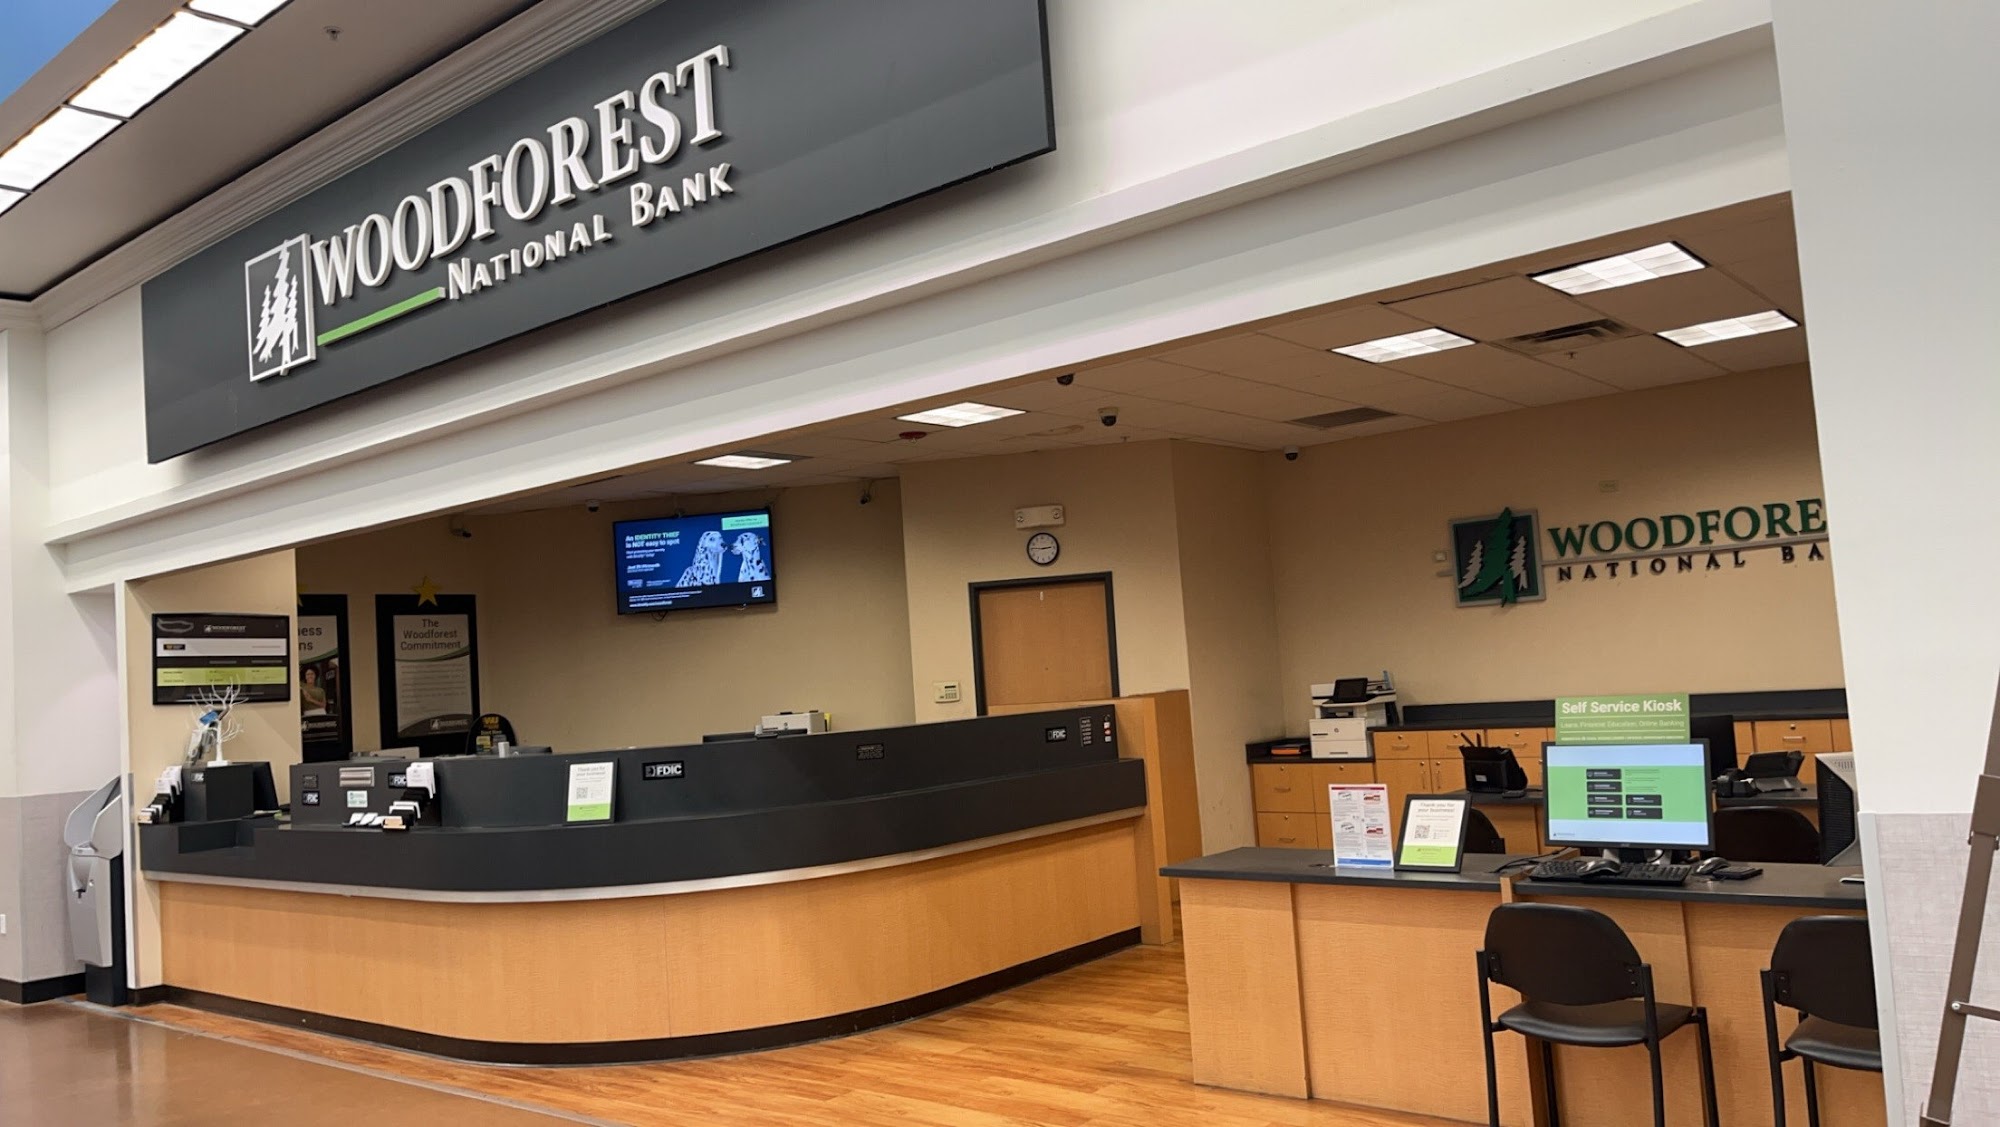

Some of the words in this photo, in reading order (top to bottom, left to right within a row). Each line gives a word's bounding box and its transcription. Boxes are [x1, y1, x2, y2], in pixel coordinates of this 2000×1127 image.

[310, 45, 731, 306] WOODFOREST
[448, 214, 612, 300] NATIONAL
[631, 162, 734, 227] BANK
[1548, 498, 1827, 558] WOODFORE
[632, 540, 645, 548] NOT
[1558, 550, 1747, 582] NATIONAL
[1781, 542, 1825, 563] BA
[422, 619, 440, 628] The
[403, 629, 458, 639] Woodforest
[400, 641, 461, 651] Commitment
[1562, 702, 1587, 714] Self
[1590, 701, 1640, 713] Service
[1643, 699, 1682, 712] Kiosk
[1659, 719, 1685, 728] Banking
[1052, 729, 1066, 740] FDIC
[656, 764, 683, 776] FDIC
